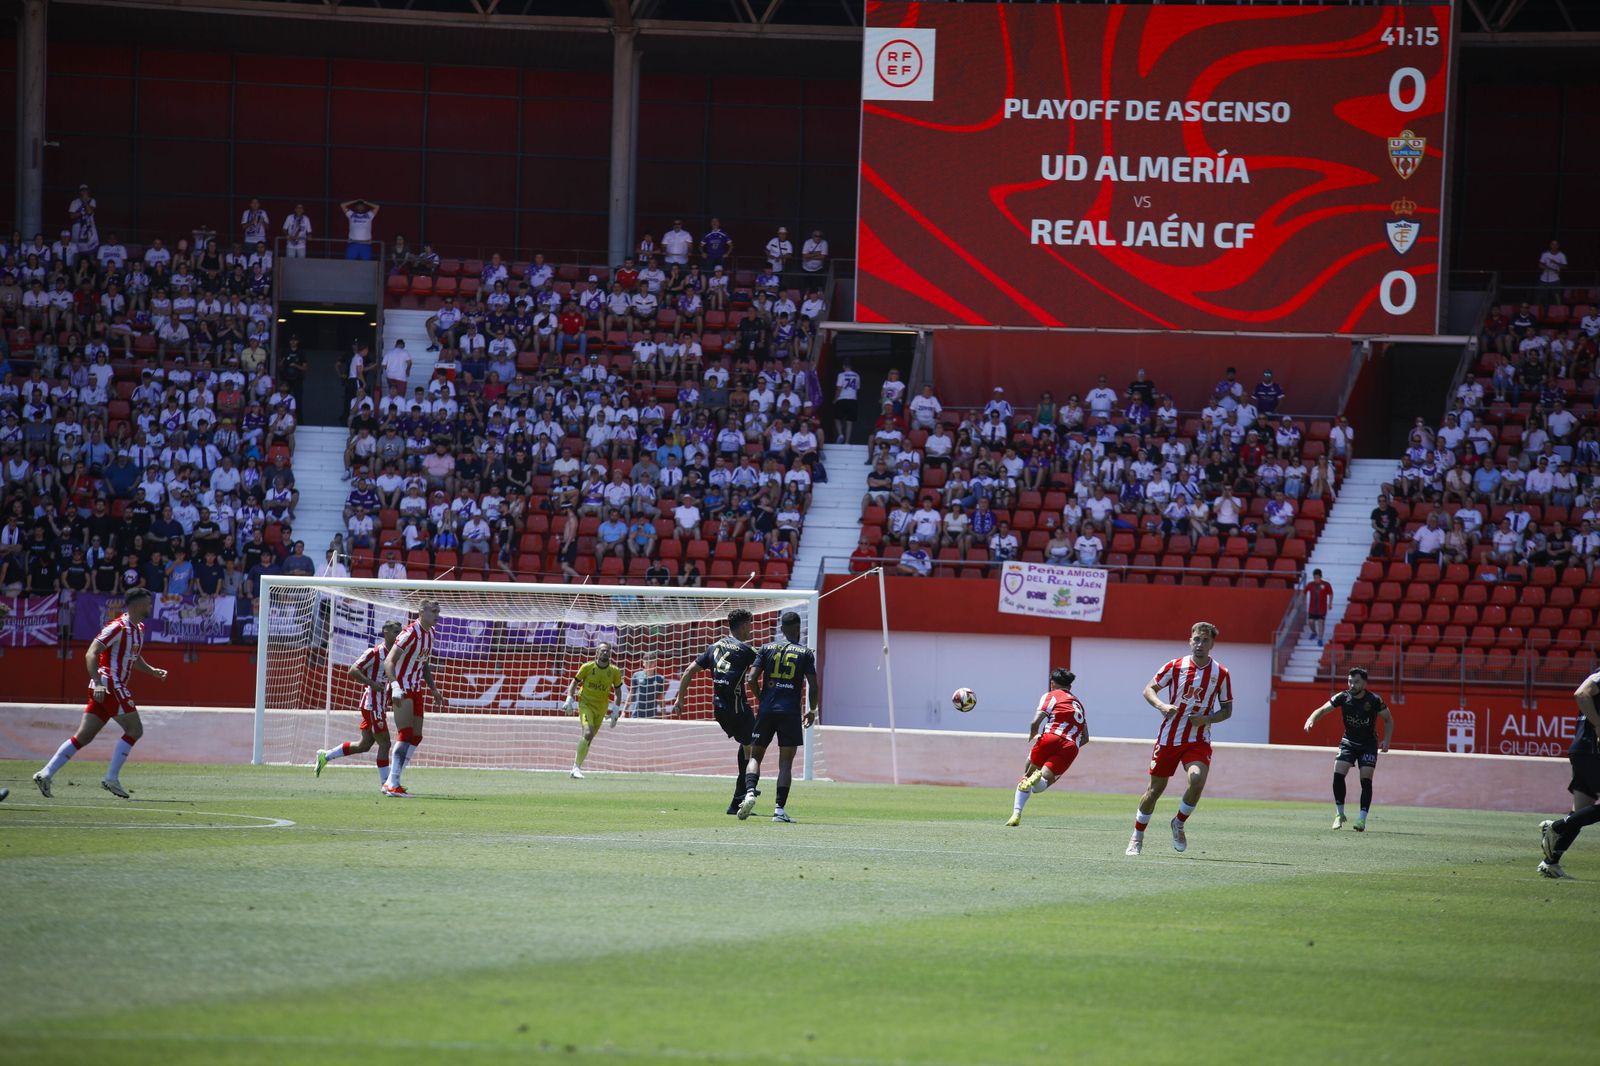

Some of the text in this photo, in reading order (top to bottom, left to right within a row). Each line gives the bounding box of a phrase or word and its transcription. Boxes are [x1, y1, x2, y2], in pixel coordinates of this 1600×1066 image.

[1381, 27, 1440, 46] 41:15
[1389, 67, 1426, 112] 0
[1004, 98, 1291, 123] PLAYOFF DE ASCENSO
[1041, 149, 1250, 183] UD ALMERÍA
[1133, 195, 1151, 208] VS
[1030, 213, 1255, 249] REAL JAÉN CF
[1380, 270, 1417, 315] 0
[1026, 575, 1043, 583] DEL
[1067, 569, 1105, 578] AMIGOS
[769, 652, 798, 680] 15
[1500, 739, 1562, 756] CIUDAD
